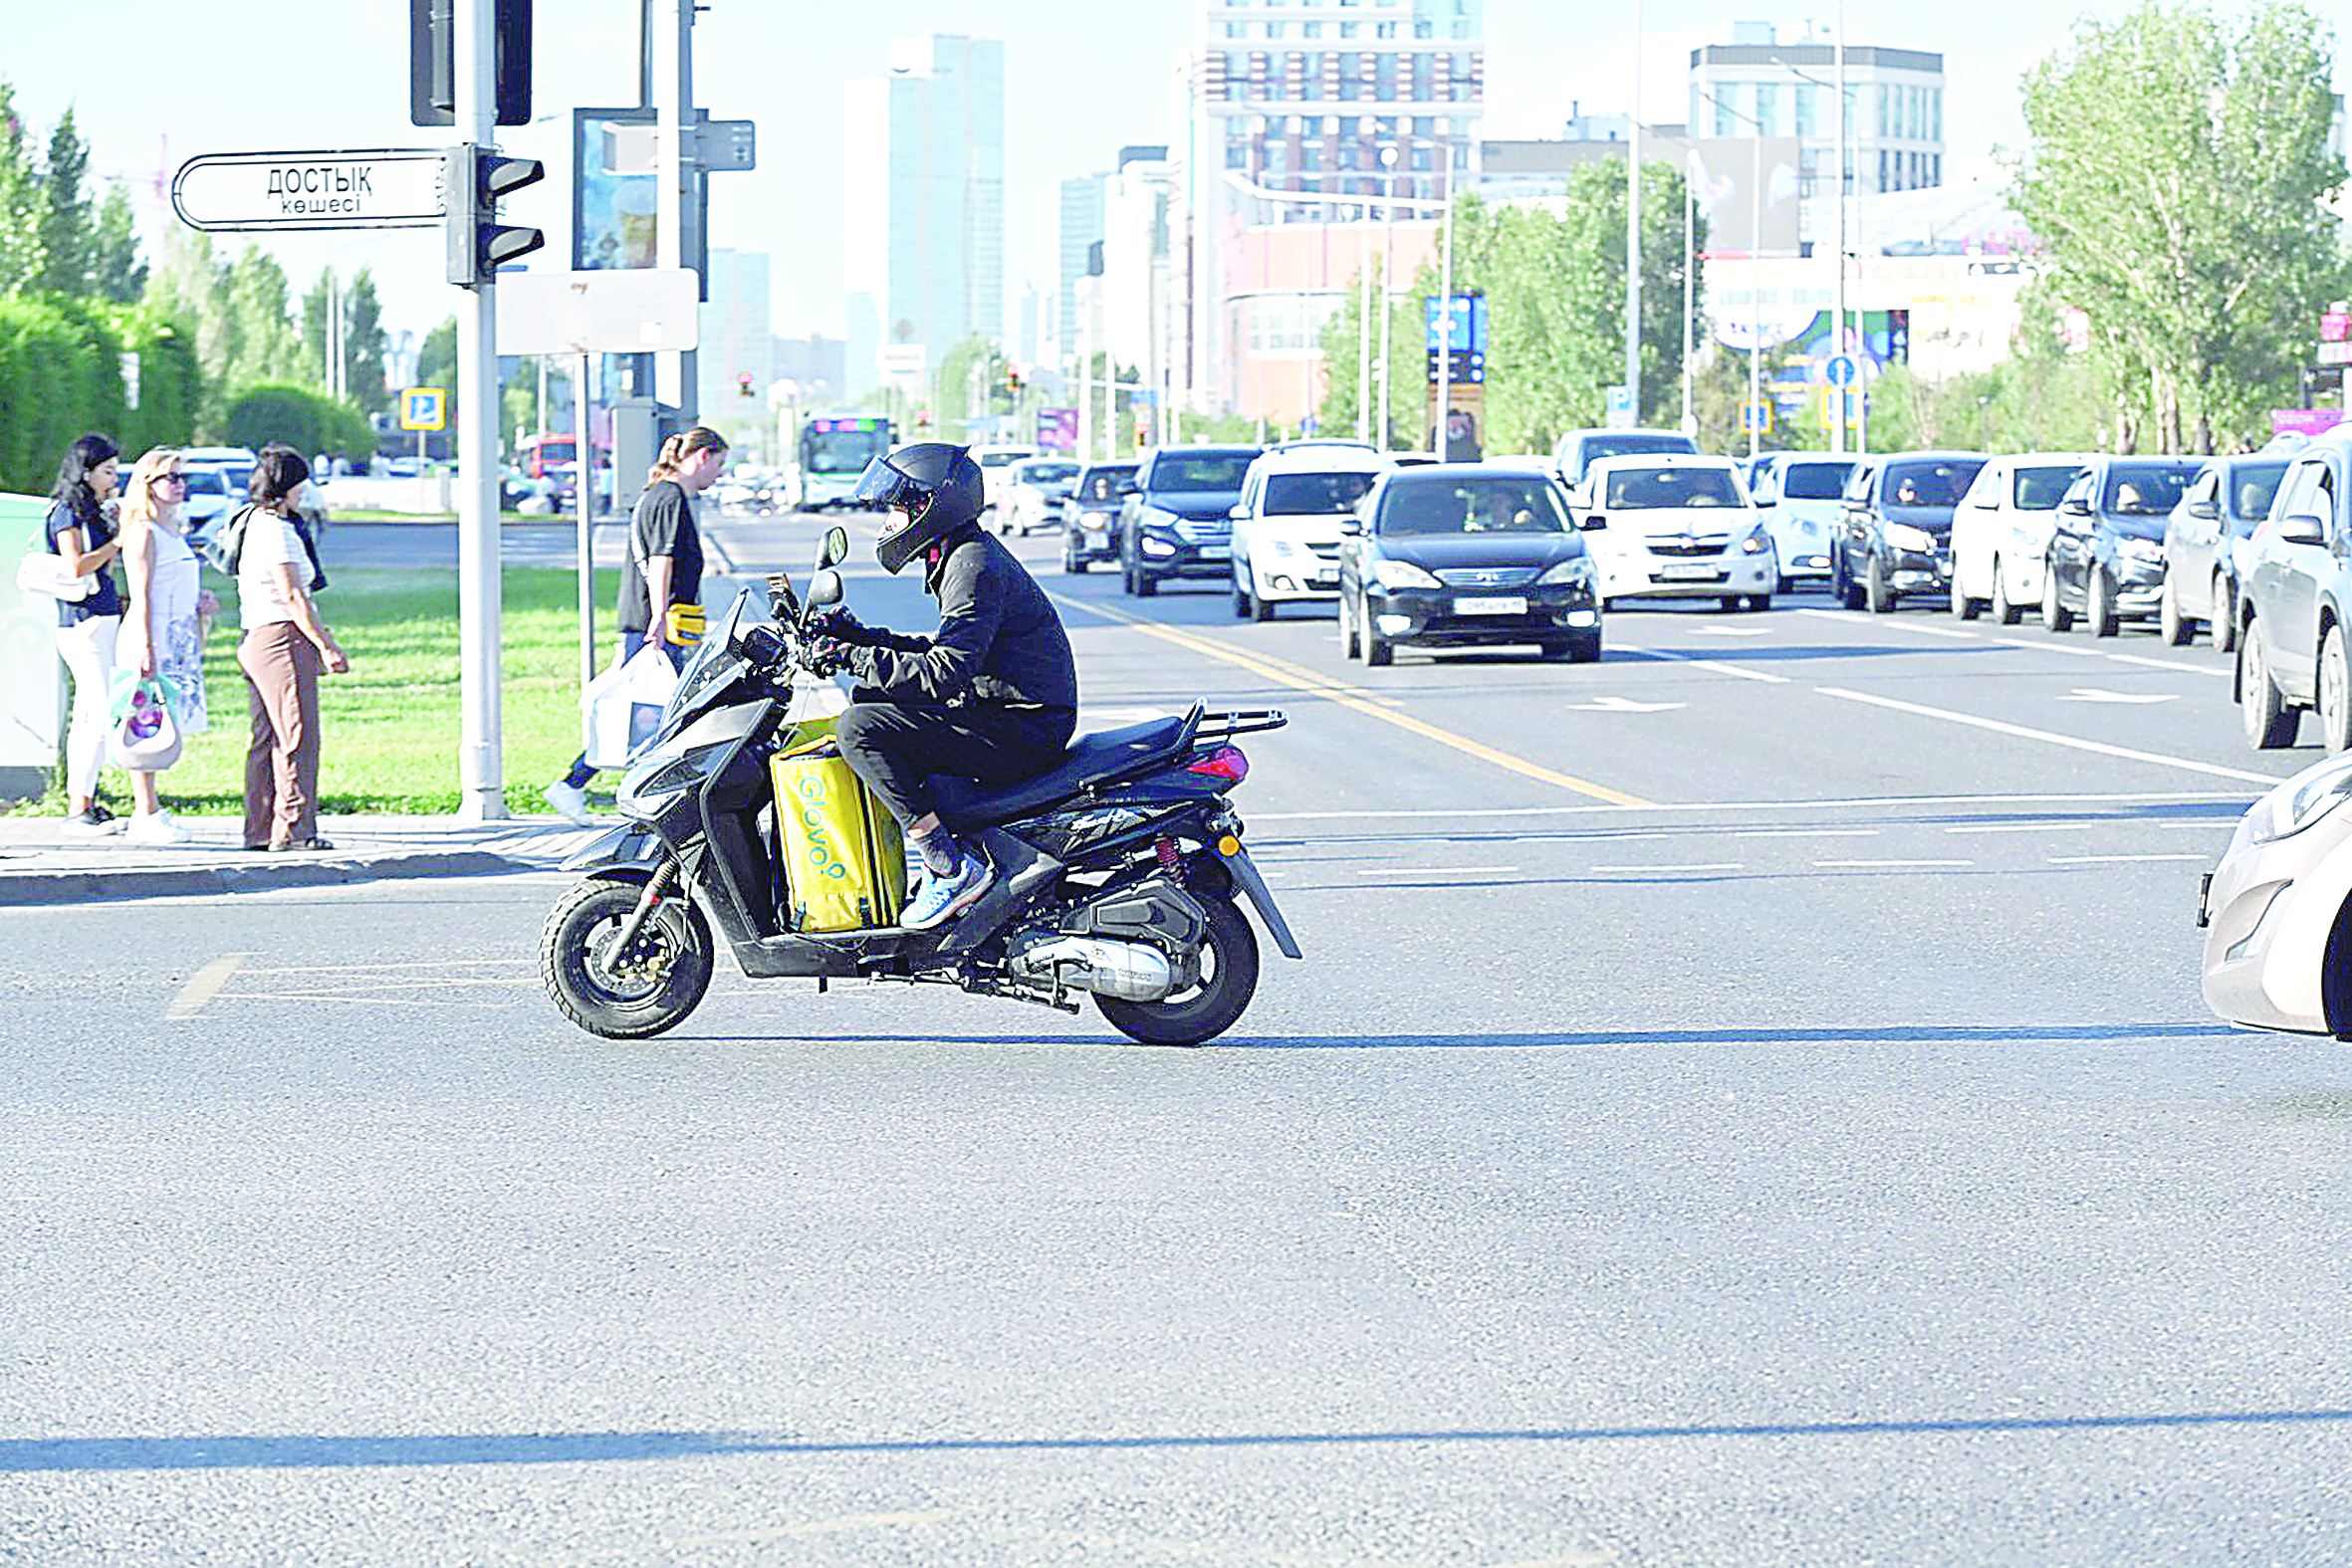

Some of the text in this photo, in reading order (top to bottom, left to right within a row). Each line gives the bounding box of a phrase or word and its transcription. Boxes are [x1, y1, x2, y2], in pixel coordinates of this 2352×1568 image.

[267, 166, 372, 198] ДОСТЫҚ
[282, 194, 360, 213] көшесі
[800, 777, 829, 867] Glovo
